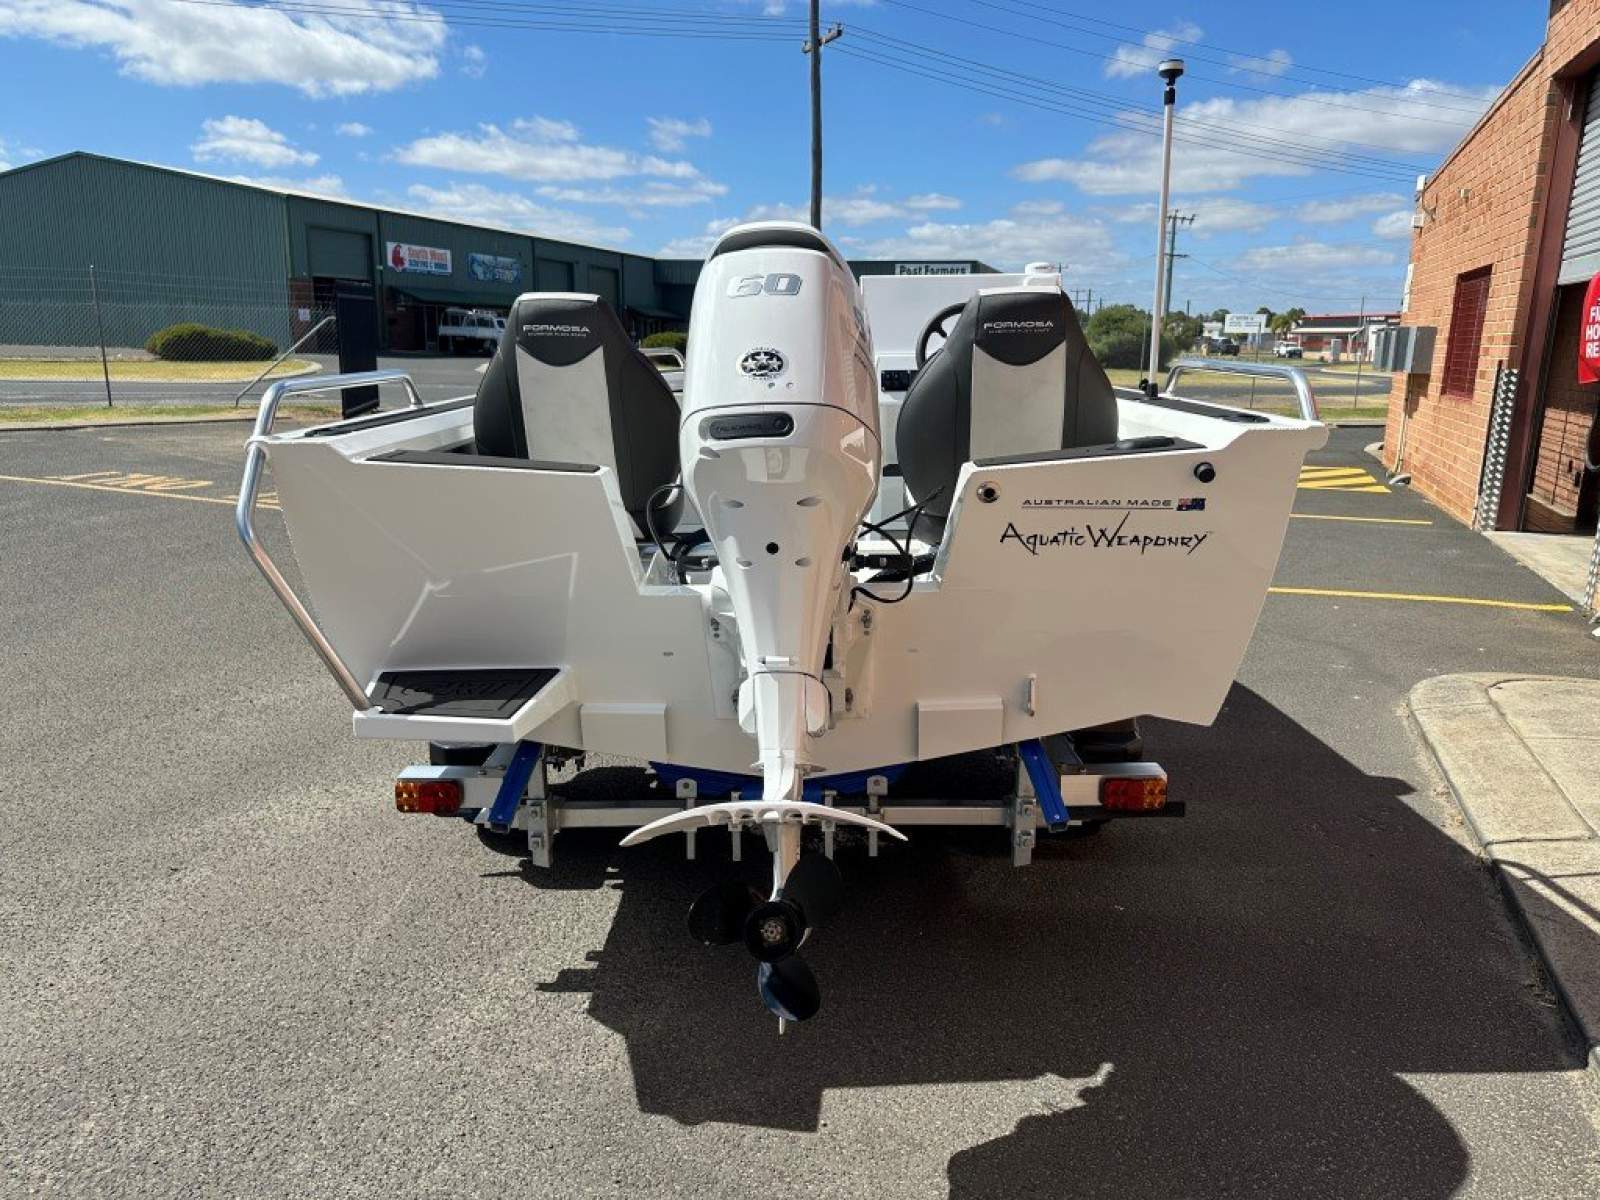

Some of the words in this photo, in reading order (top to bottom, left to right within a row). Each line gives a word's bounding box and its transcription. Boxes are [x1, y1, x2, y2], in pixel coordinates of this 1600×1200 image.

[727, 273, 802, 298] 60
[523, 324, 591, 333] FORMOSA
[984, 320, 1054, 330] FORMOSA
[1022, 499, 1121, 507] AUSTRALIAN
[1126, 499, 1172, 507] MADE
[1000, 522, 1086, 556] Aquatic
[1086, 511, 1208, 556] Weaponry
